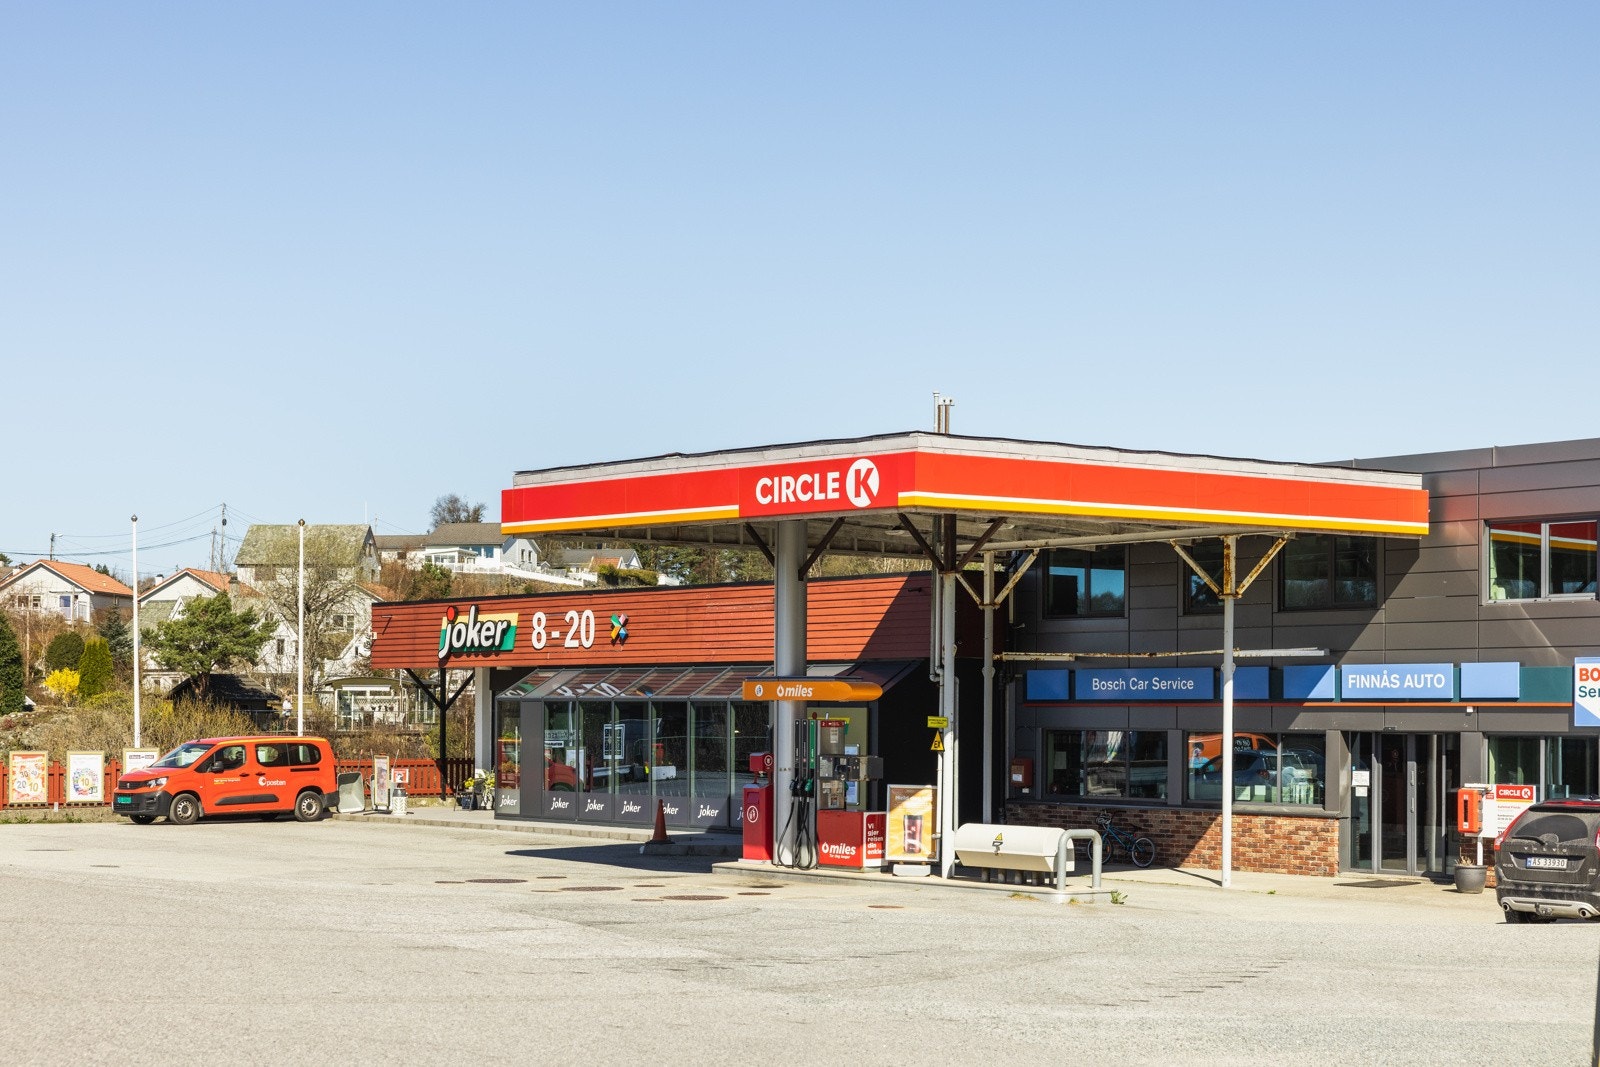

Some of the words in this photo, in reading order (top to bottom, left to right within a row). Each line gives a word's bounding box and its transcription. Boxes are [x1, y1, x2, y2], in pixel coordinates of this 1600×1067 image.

[756, 471, 840, 505] CIRCLE
[851, 463, 878, 506] K
[438, 604, 509, 659] joker
[1092, 677, 1126, 691] Bosch
[1129, 677, 1149, 690] Car
[1152, 677, 1194, 690] Service
[1348, 669, 1400, 689] FINNÅS
[1404, 673, 1446, 689] AUTO
[784, 684, 813, 697] miles
[1498, 789, 1521, 797] CIRCLE
[1522, 789, 1530, 798] K
[499, 794, 517, 807] joker
[551, 797, 570, 810] joker
[585, 799, 605, 812] joker
[621, 800, 641, 814] joker
[662, 802, 679, 815] oker
[697, 804, 719, 818] joker
[829, 843, 856, 855] miles
[1532, 857, 1541, 866] AS
[1543, 858, 1565, 867] 33930
